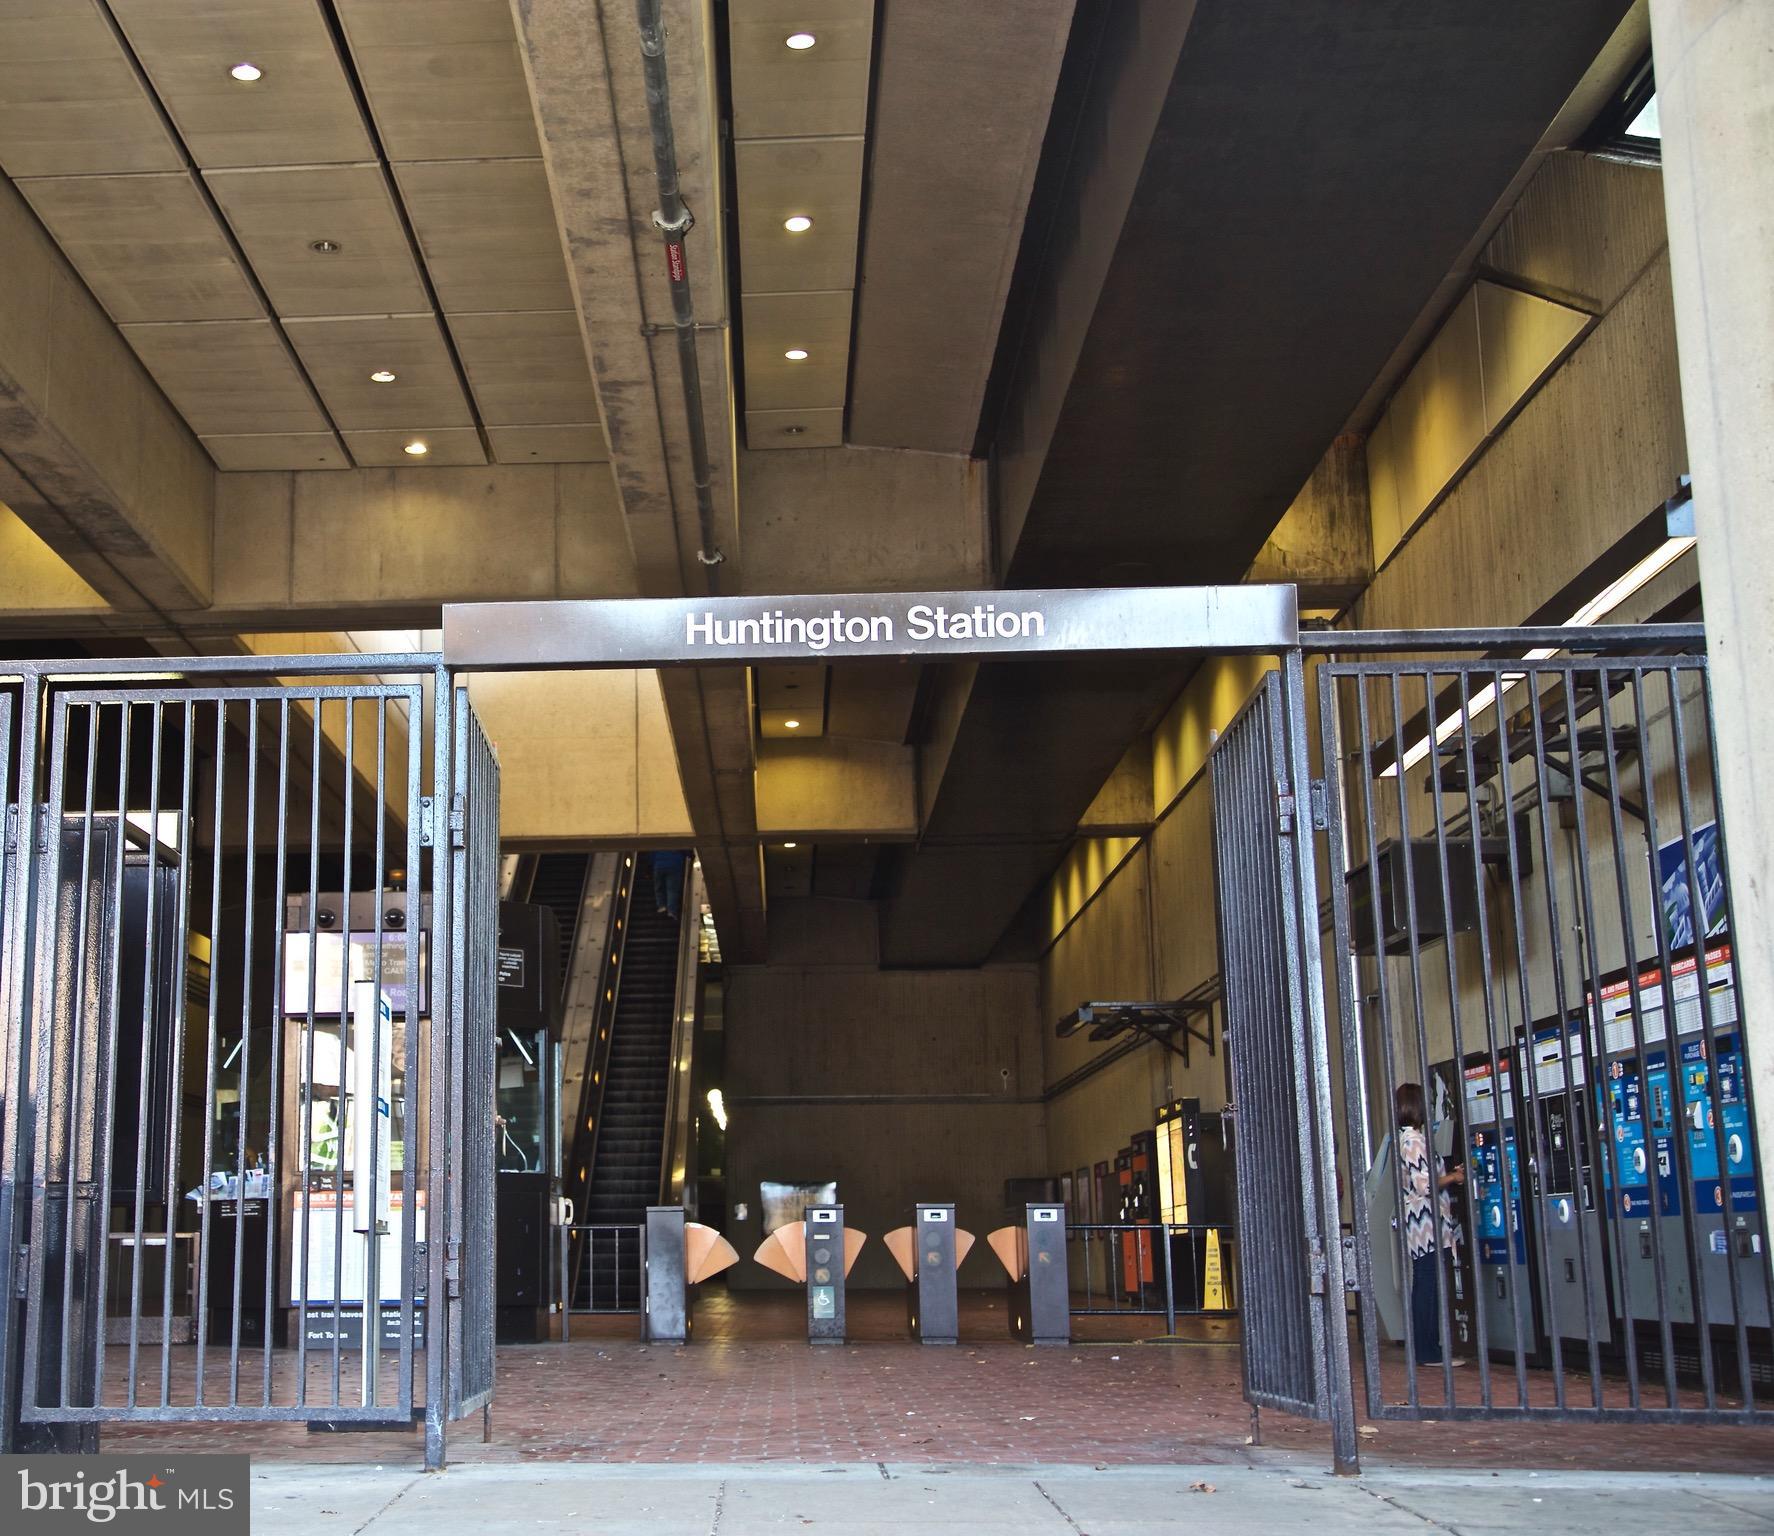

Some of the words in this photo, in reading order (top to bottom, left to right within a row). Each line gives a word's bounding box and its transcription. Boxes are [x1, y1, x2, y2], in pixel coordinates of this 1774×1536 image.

[686, 610, 893, 650] Huntington
[907, 604, 1044, 640] Station
[308, 1331, 323, 1339] Fort
